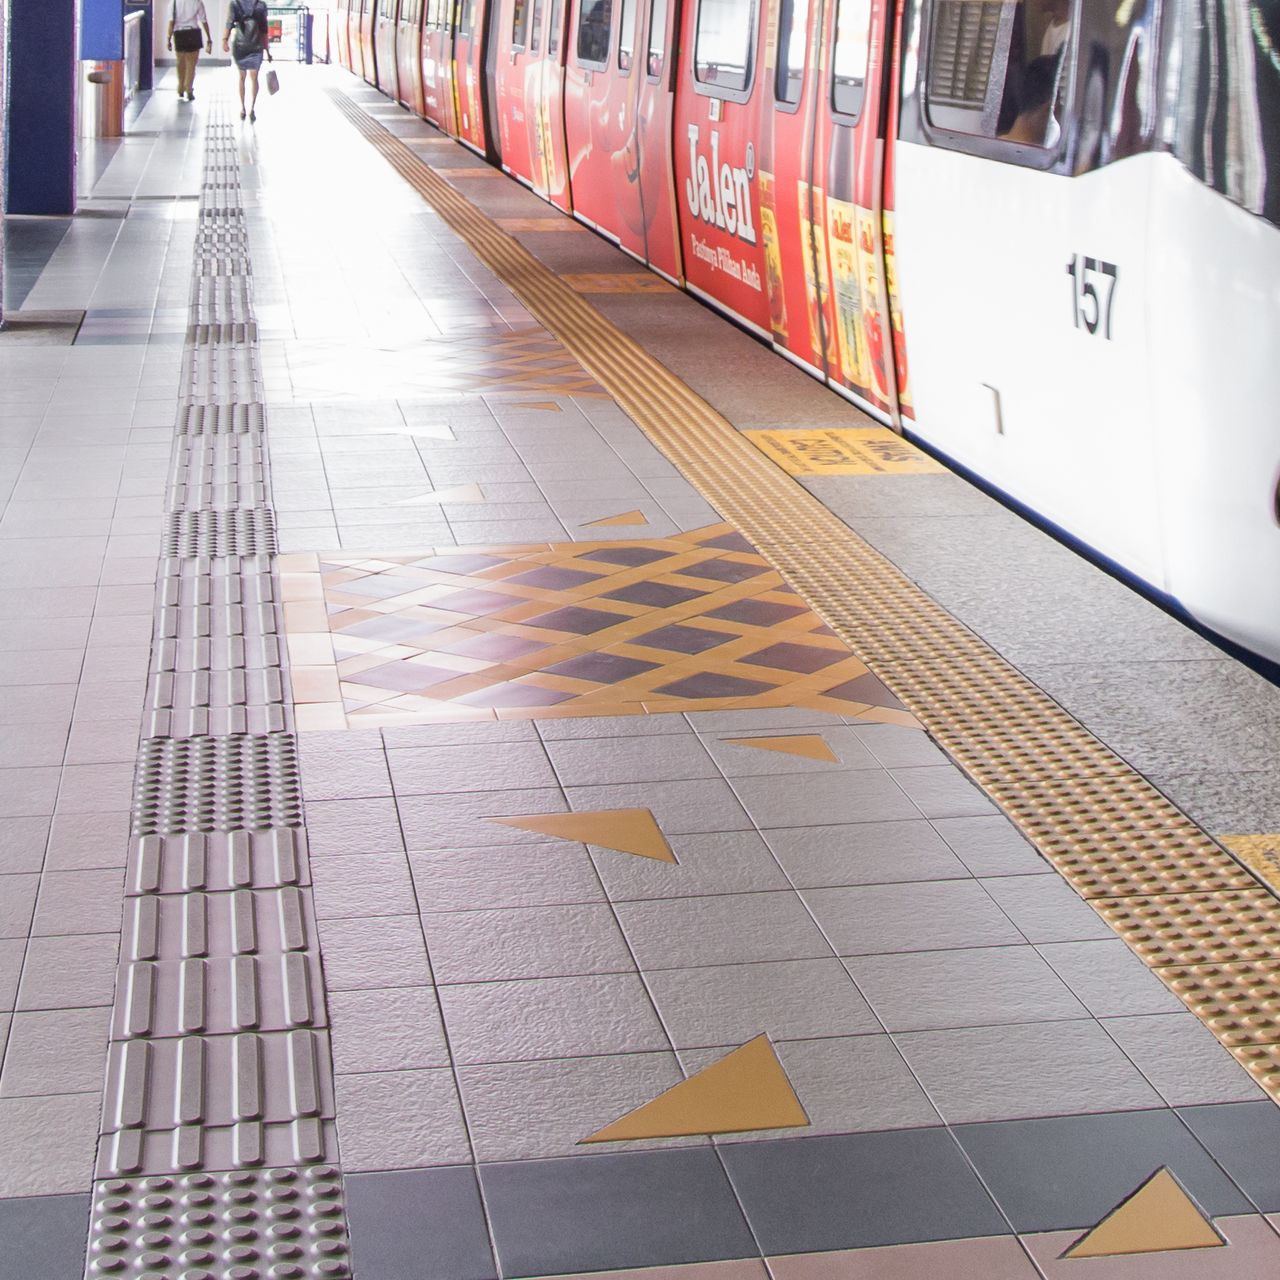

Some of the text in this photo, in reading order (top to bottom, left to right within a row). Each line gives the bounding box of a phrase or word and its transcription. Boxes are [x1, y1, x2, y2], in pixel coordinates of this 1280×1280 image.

[686, 124, 757, 246] Jalen
[741, 259, 762, 291] Anda
[1066, 252, 1118, 341] 157
